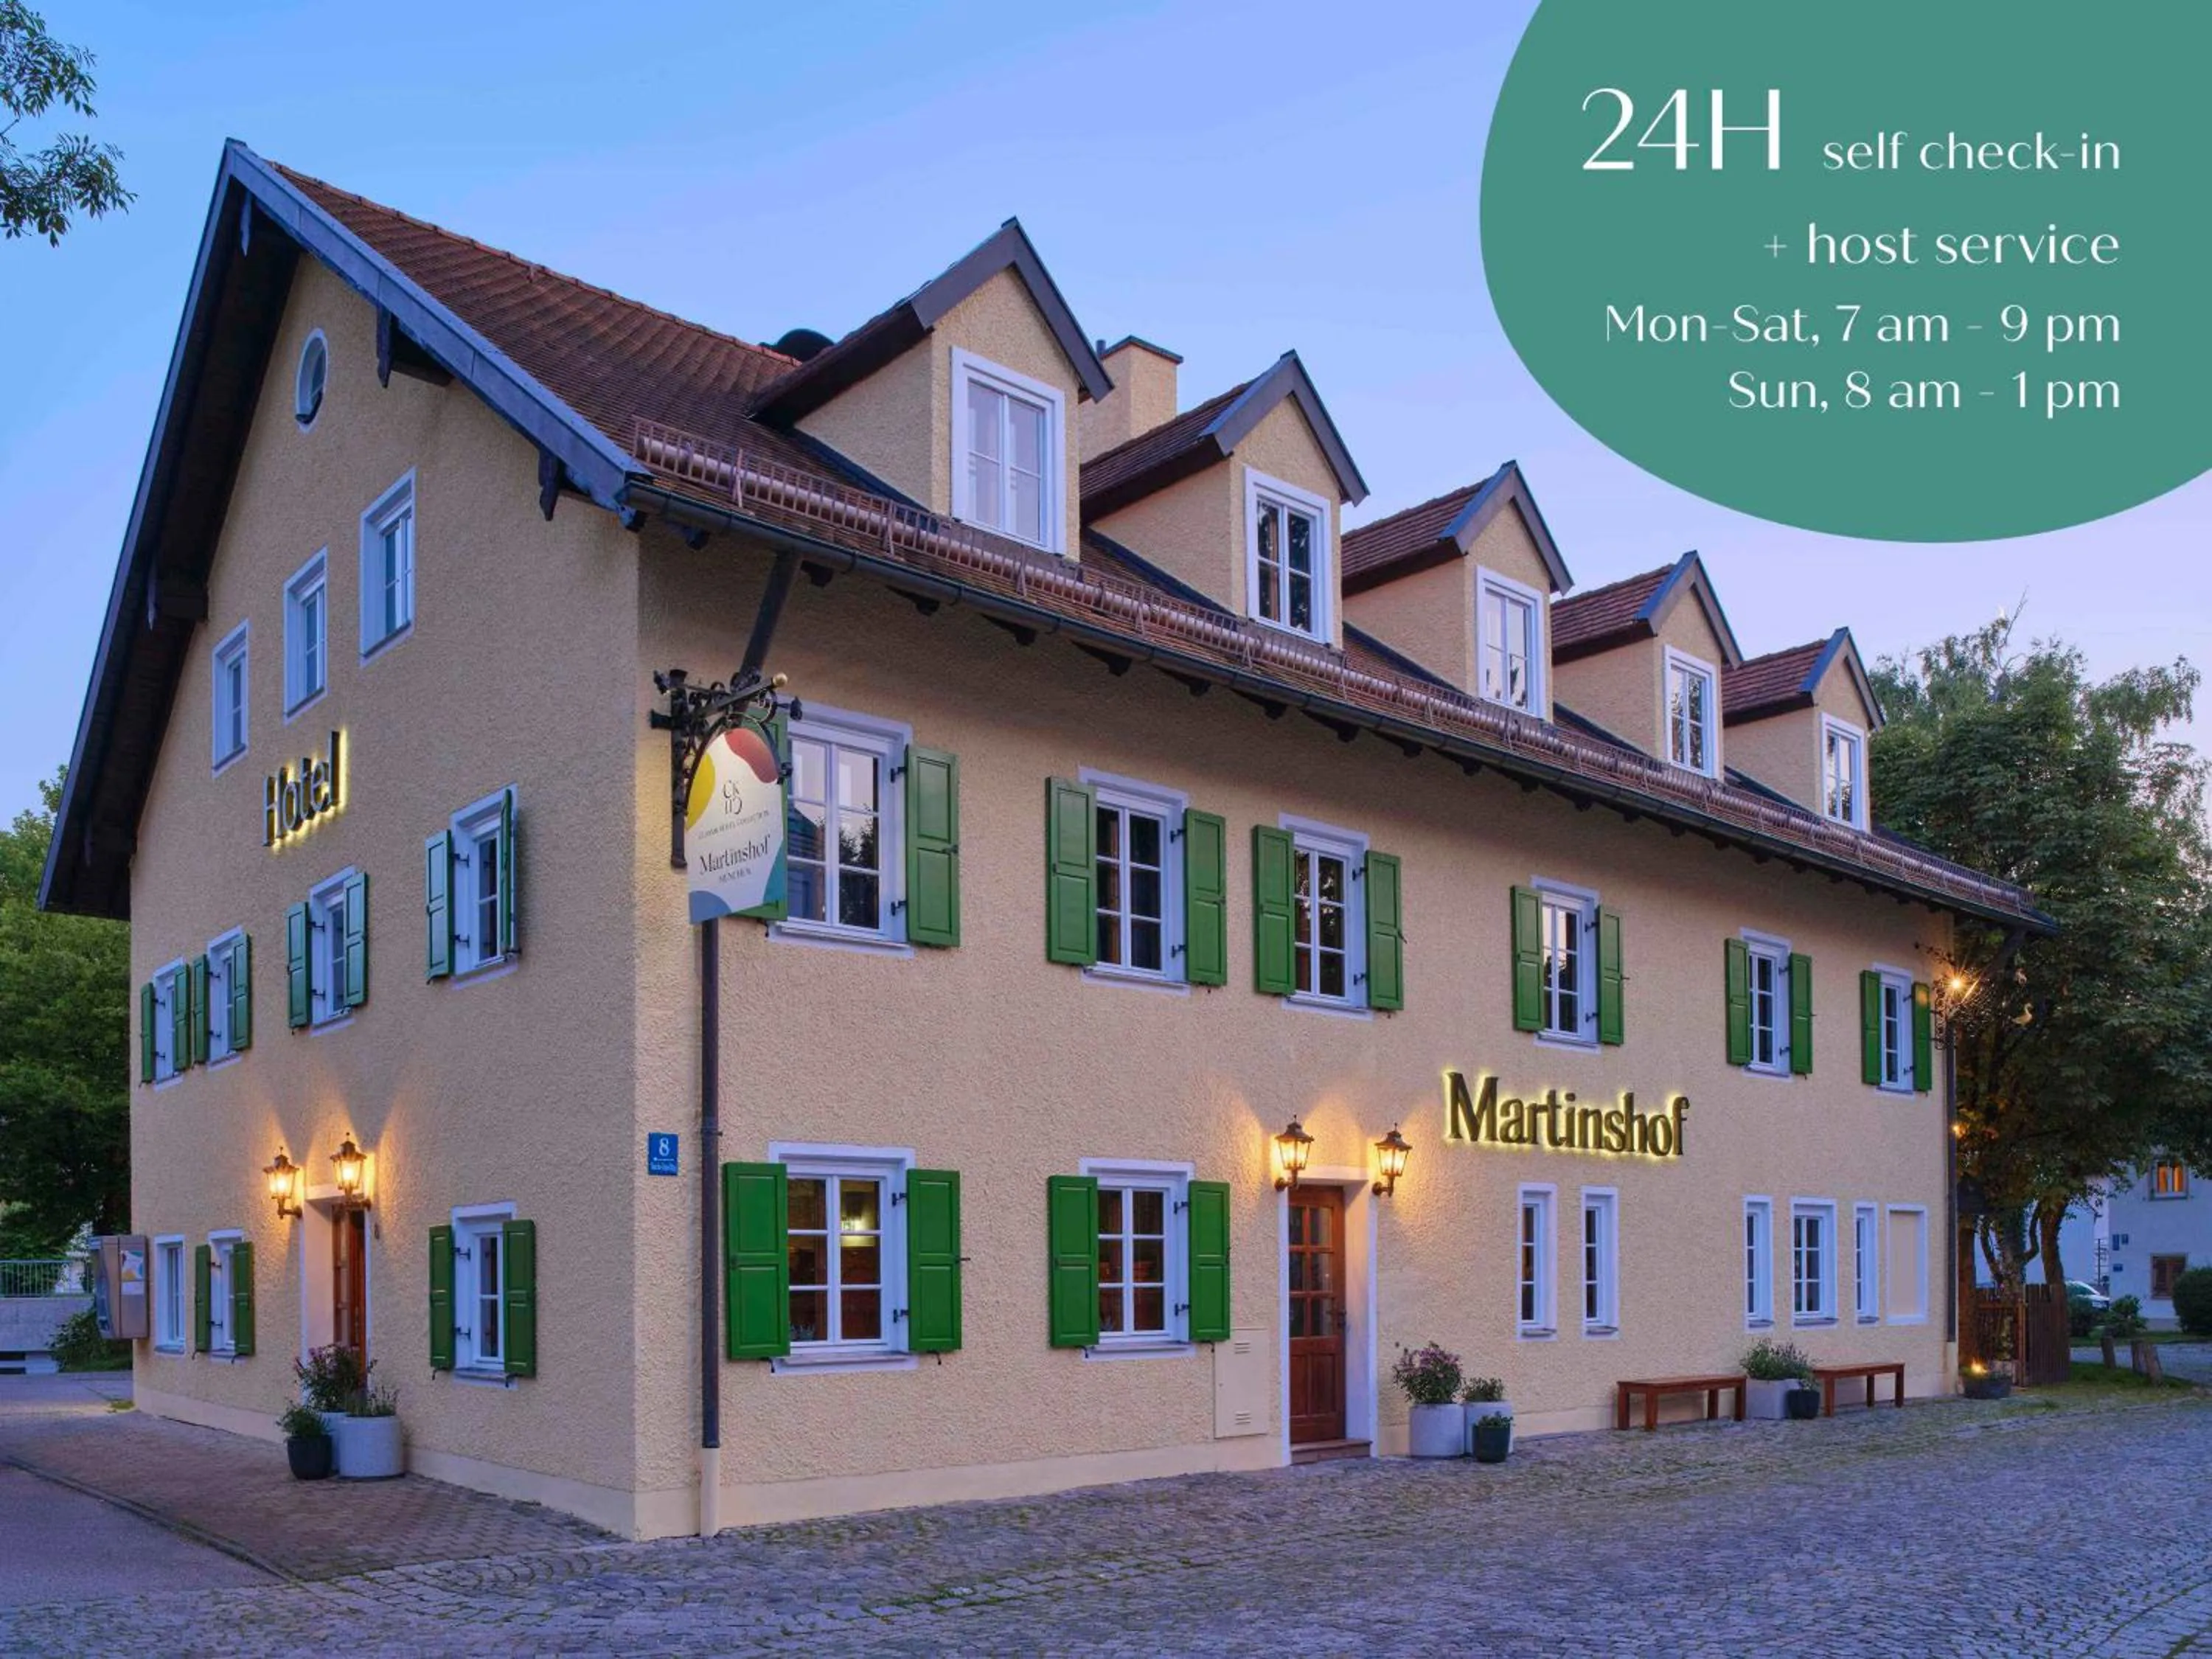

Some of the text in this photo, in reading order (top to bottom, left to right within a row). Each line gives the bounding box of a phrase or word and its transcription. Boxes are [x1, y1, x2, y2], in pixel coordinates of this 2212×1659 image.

[262, 730, 340, 846] Hotel
[700, 834, 771, 875] Martinshof
[1447, 1071, 1689, 1156] Martinshof
[658, 1138, 669, 1157] 8
